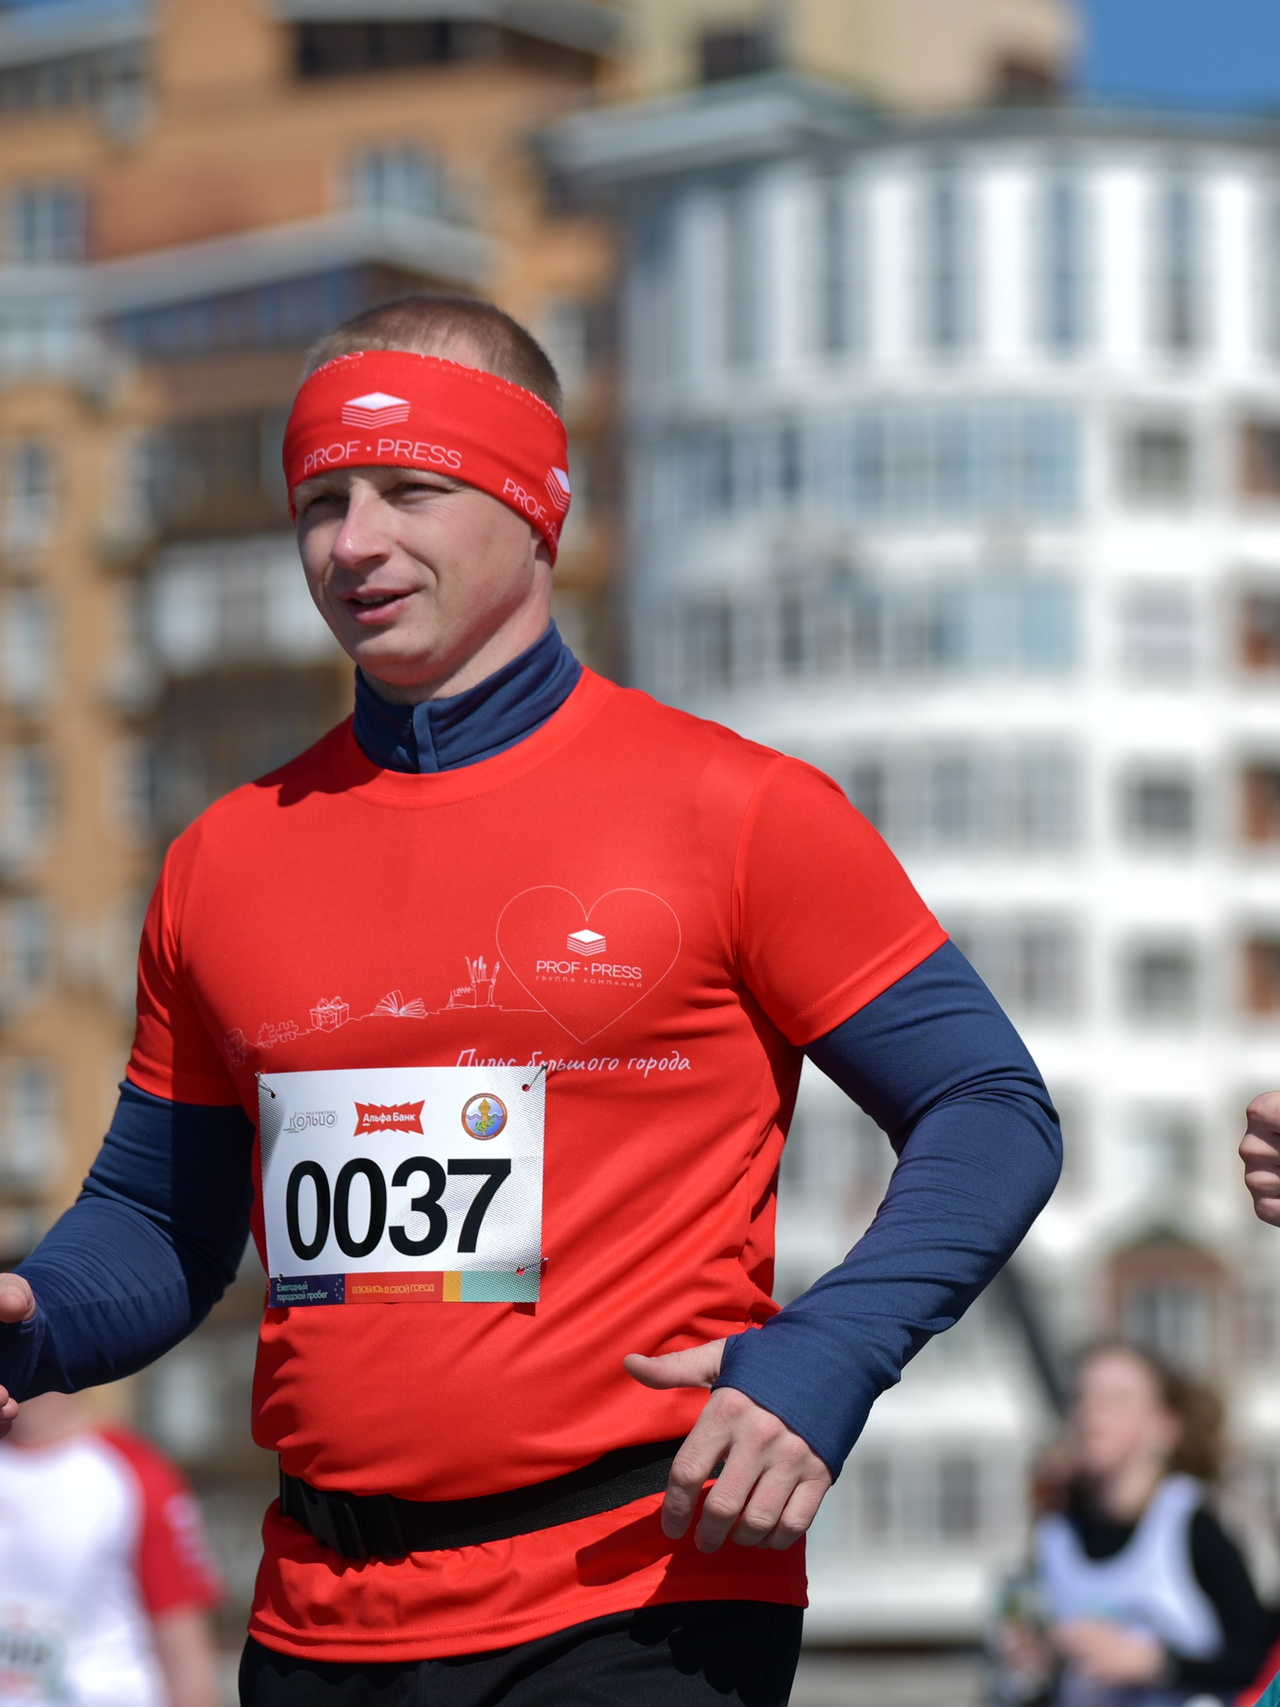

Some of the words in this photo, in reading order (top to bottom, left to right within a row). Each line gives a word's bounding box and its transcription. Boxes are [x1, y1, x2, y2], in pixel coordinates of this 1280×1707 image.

[304, 440, 361, 475] PROF
[376, 438, 463, 469] PRESS
[502, 477, 547, 520] PROF
[535, 975, 576, 983] ГРУППА
[583, 978, 642, 988] КОМПАНИЙ
[536, 960, 581, 974] PROF
[591, 962, 642, 980] PRESS
[627, 1050, 692, 1078] города
[362, 1113, 392, 1126] Альфа
[393, 1111, 415, 1122] Банк
[286, 1156, 511, 1261] 0037
